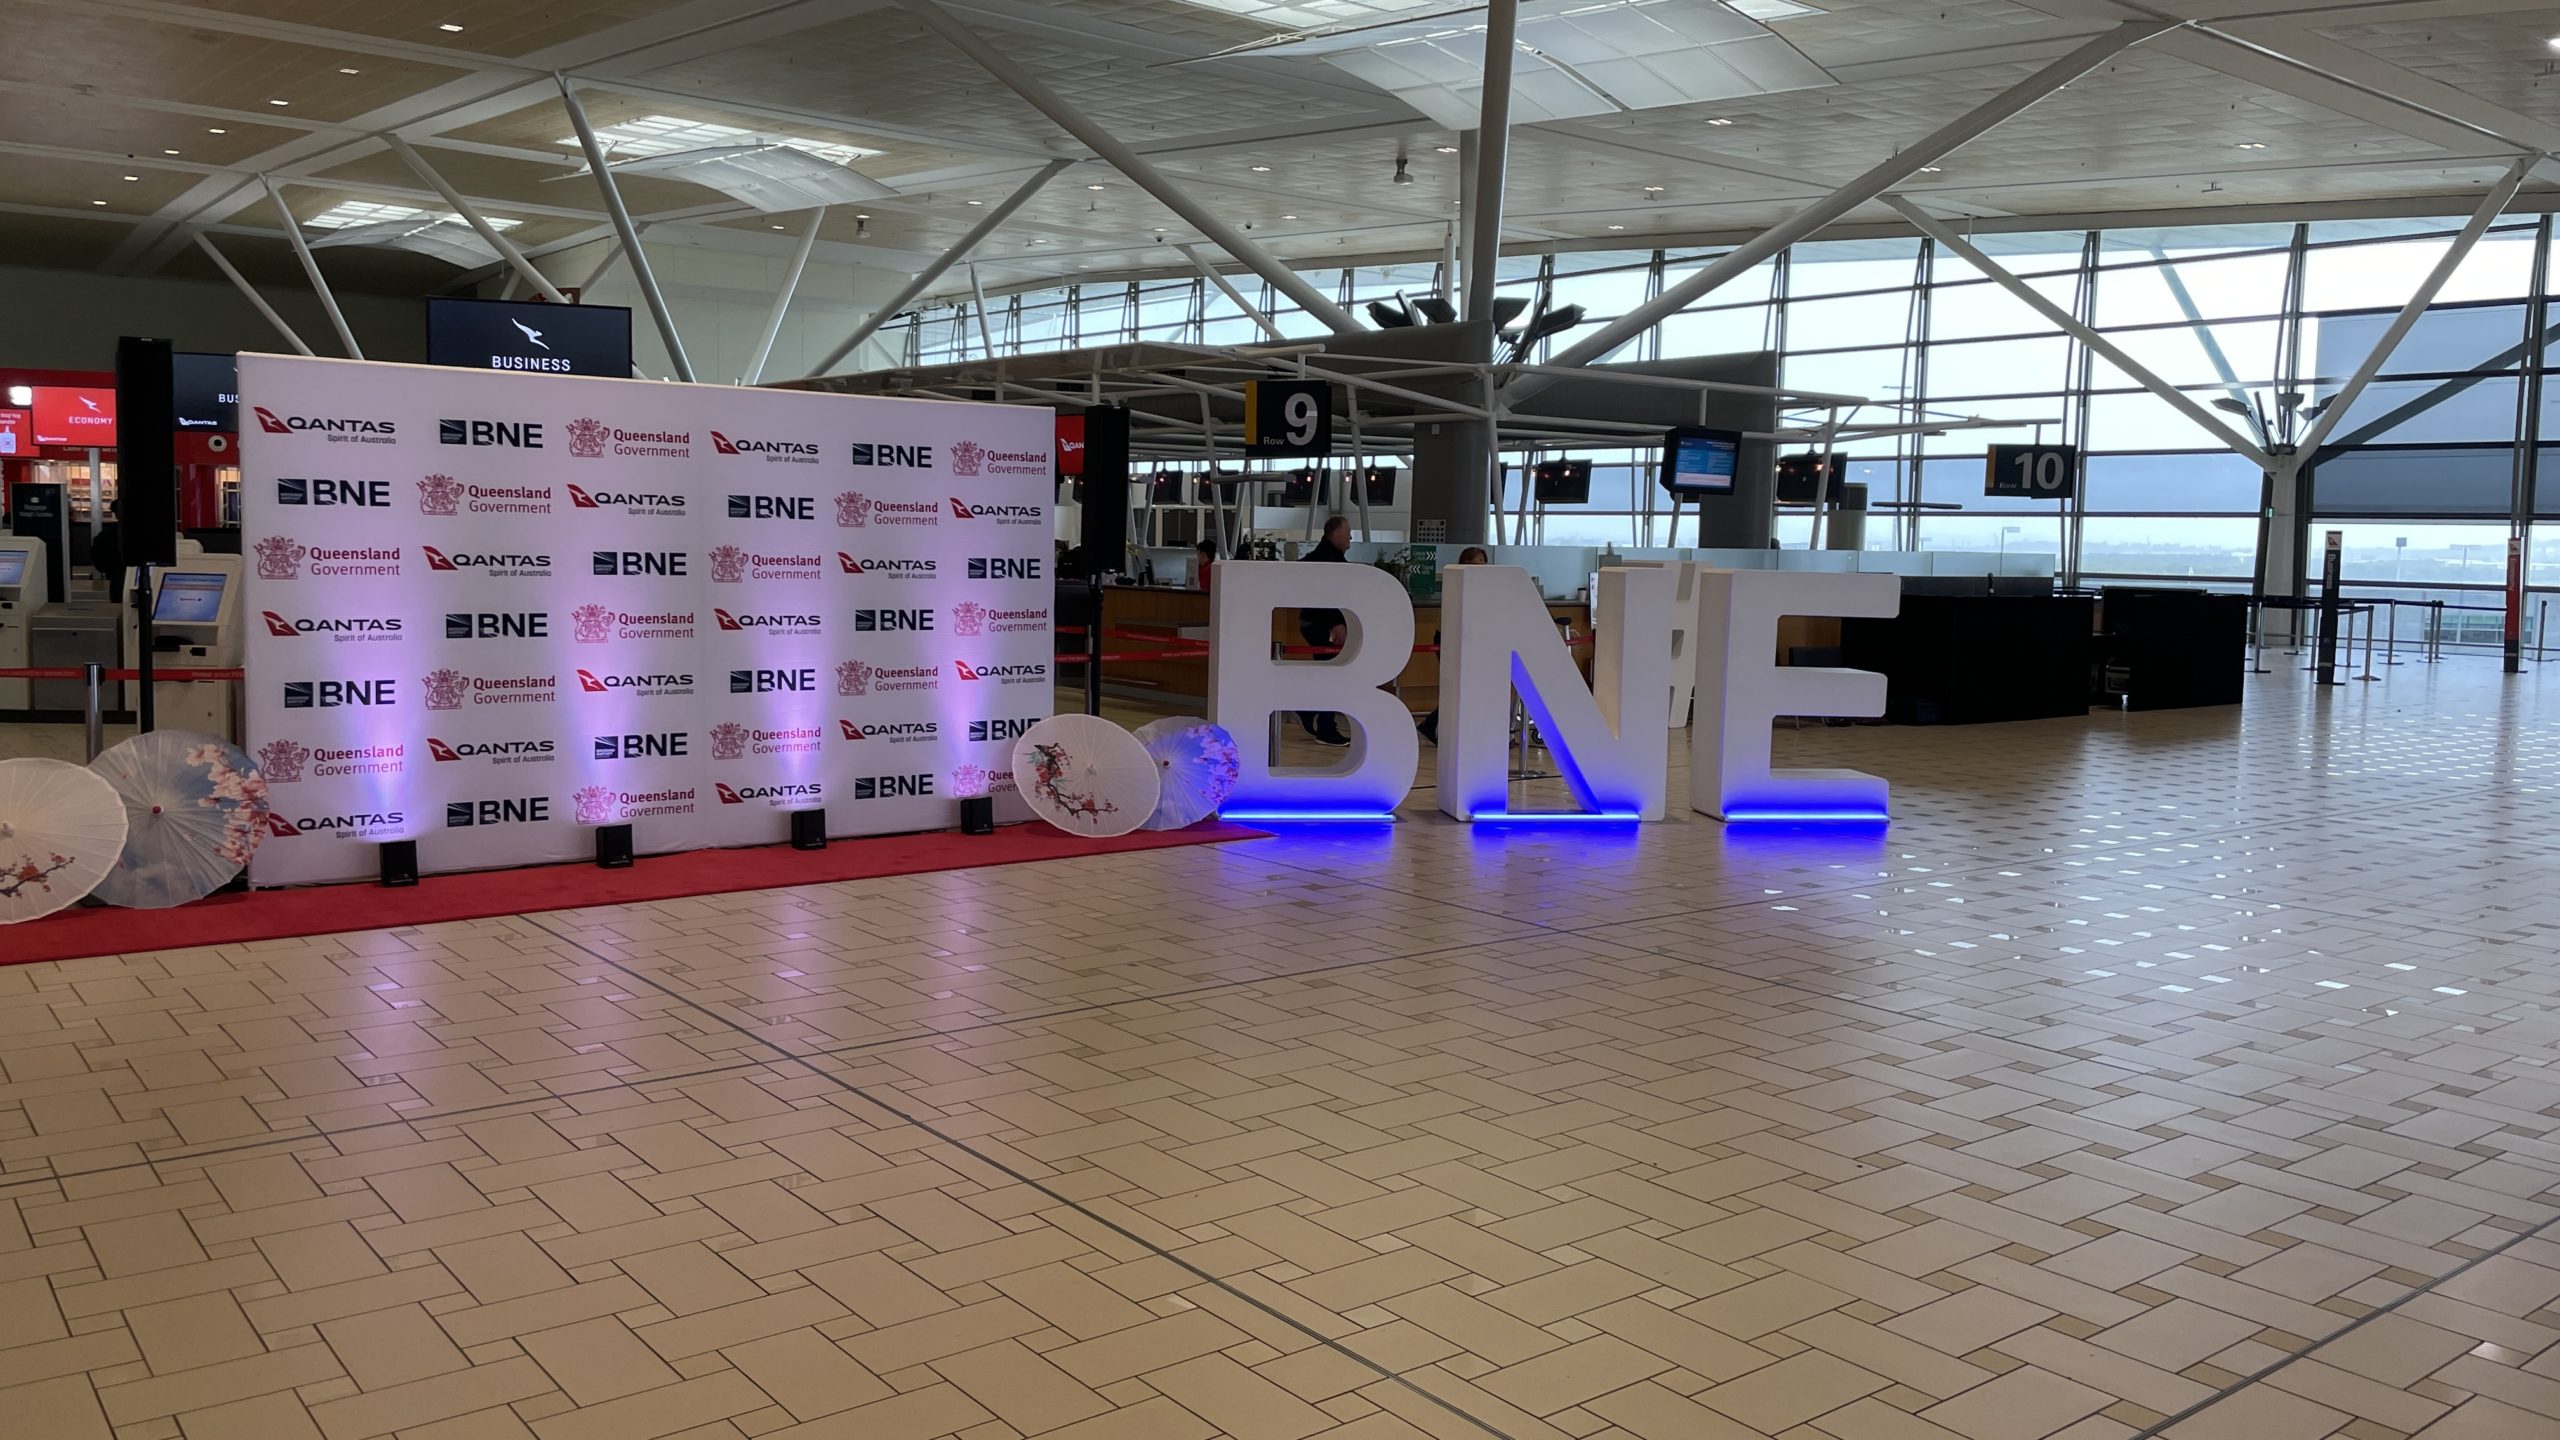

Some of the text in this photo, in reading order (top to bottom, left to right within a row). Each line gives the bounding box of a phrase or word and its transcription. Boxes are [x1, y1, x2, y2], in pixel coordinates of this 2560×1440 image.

[492, 355, 572, 372] BUSINESS
[69, 416, 112, 425] ECONOMY
[287, 417, 395, 434] QANTAS
[1264, 392, 1318, 446] Row 9
[328, 434, 349, 442] Spirit
[360, 436, 396, 444] Australia
[472, 421, 543, 448] BNE
[614, 429, 689, 444] Queensland
[614, 444, 690, 458] Government
[736, 440, 818, 454] QANTAS
[878, 444, 932, 468] BNE
[988, 450, 1046, 462] Queensland
[988, 463, 1046, 475] Government
[2015, 452, 2064, 490] 10
[313, 479, 390, 506] BNE
[468, 485, 551, 499] Queensland
[595, 492, 685, 506] QANTAS
[469, 500, 551, 514] Government
[756, 496, 814, 520] BNE
[874, 500, 938, 512] Queensland
[972, 505, 1040, 518] QANTAS
[874, 514, 938, 526] Government
[310, 547, 400, 561] Queensland
[453, 554, 551, 567] QANTAS
[752, 555, 820, 567] Queensland
[311, 563, 400, 575] Government
[623, 552, 686, 576] BNE
[860, 559, 936, 570] QANTAS
[991, 558, 1040, 579] BNE
[752, 568, 820, 580] Government
[619, 612, 694, 626] Queensland
[739, 615, 820, 626] QANTAS
[880, 610, 934, 631] BNE
[989, 608, 1047, 621] Queensland
[295, 619, 402, 631] QANTAS
[478, 613, 548, 638] BNE
[988, 622, 1046, 632] Government
[334, 634, 355, 643] Spirit
[619, 627, 694, 638] Government
[875, 666, 938, 680] Queensland
[976, 665, 1045, 676] QANTAS
[474, 675, 555, 691] Queensland
[604, 675, 693, 687] QANTAS
[757, 669, 815, 692] BNE
[875, 680, 938, 691] Government
[320, 680, 395, 707] BNE
[474, 691, 555, 704] Government
[636, 687, 654, 696] Spirit
[1209, 560, 1902, 824] BNE
[752, 726, 821, 742] Queensland
[862, 723, 937, 735] QANTAS
[457, 741, 554, 756] QANTAS
[624, 733, 687, 758] BNE
[752, 741, 821, 754] Government
[314, 744, 403, 762] Queensland
[492, 757, 512, 765] Spirit
[522, 755, 554, 763] Australia
[314, 760, 403, 776] Government
[740, 784, 821, 798] QANTAS
[880, 774, 933, 798] BNE
[620, 788, 694, 805] Queensland
[479, 797, 548, 825] BNE
[620, 803, 694, 818] Government
[297, 812, 404, 831] QANTAS
[336, 826, 404, 840] Spirit of Australia
